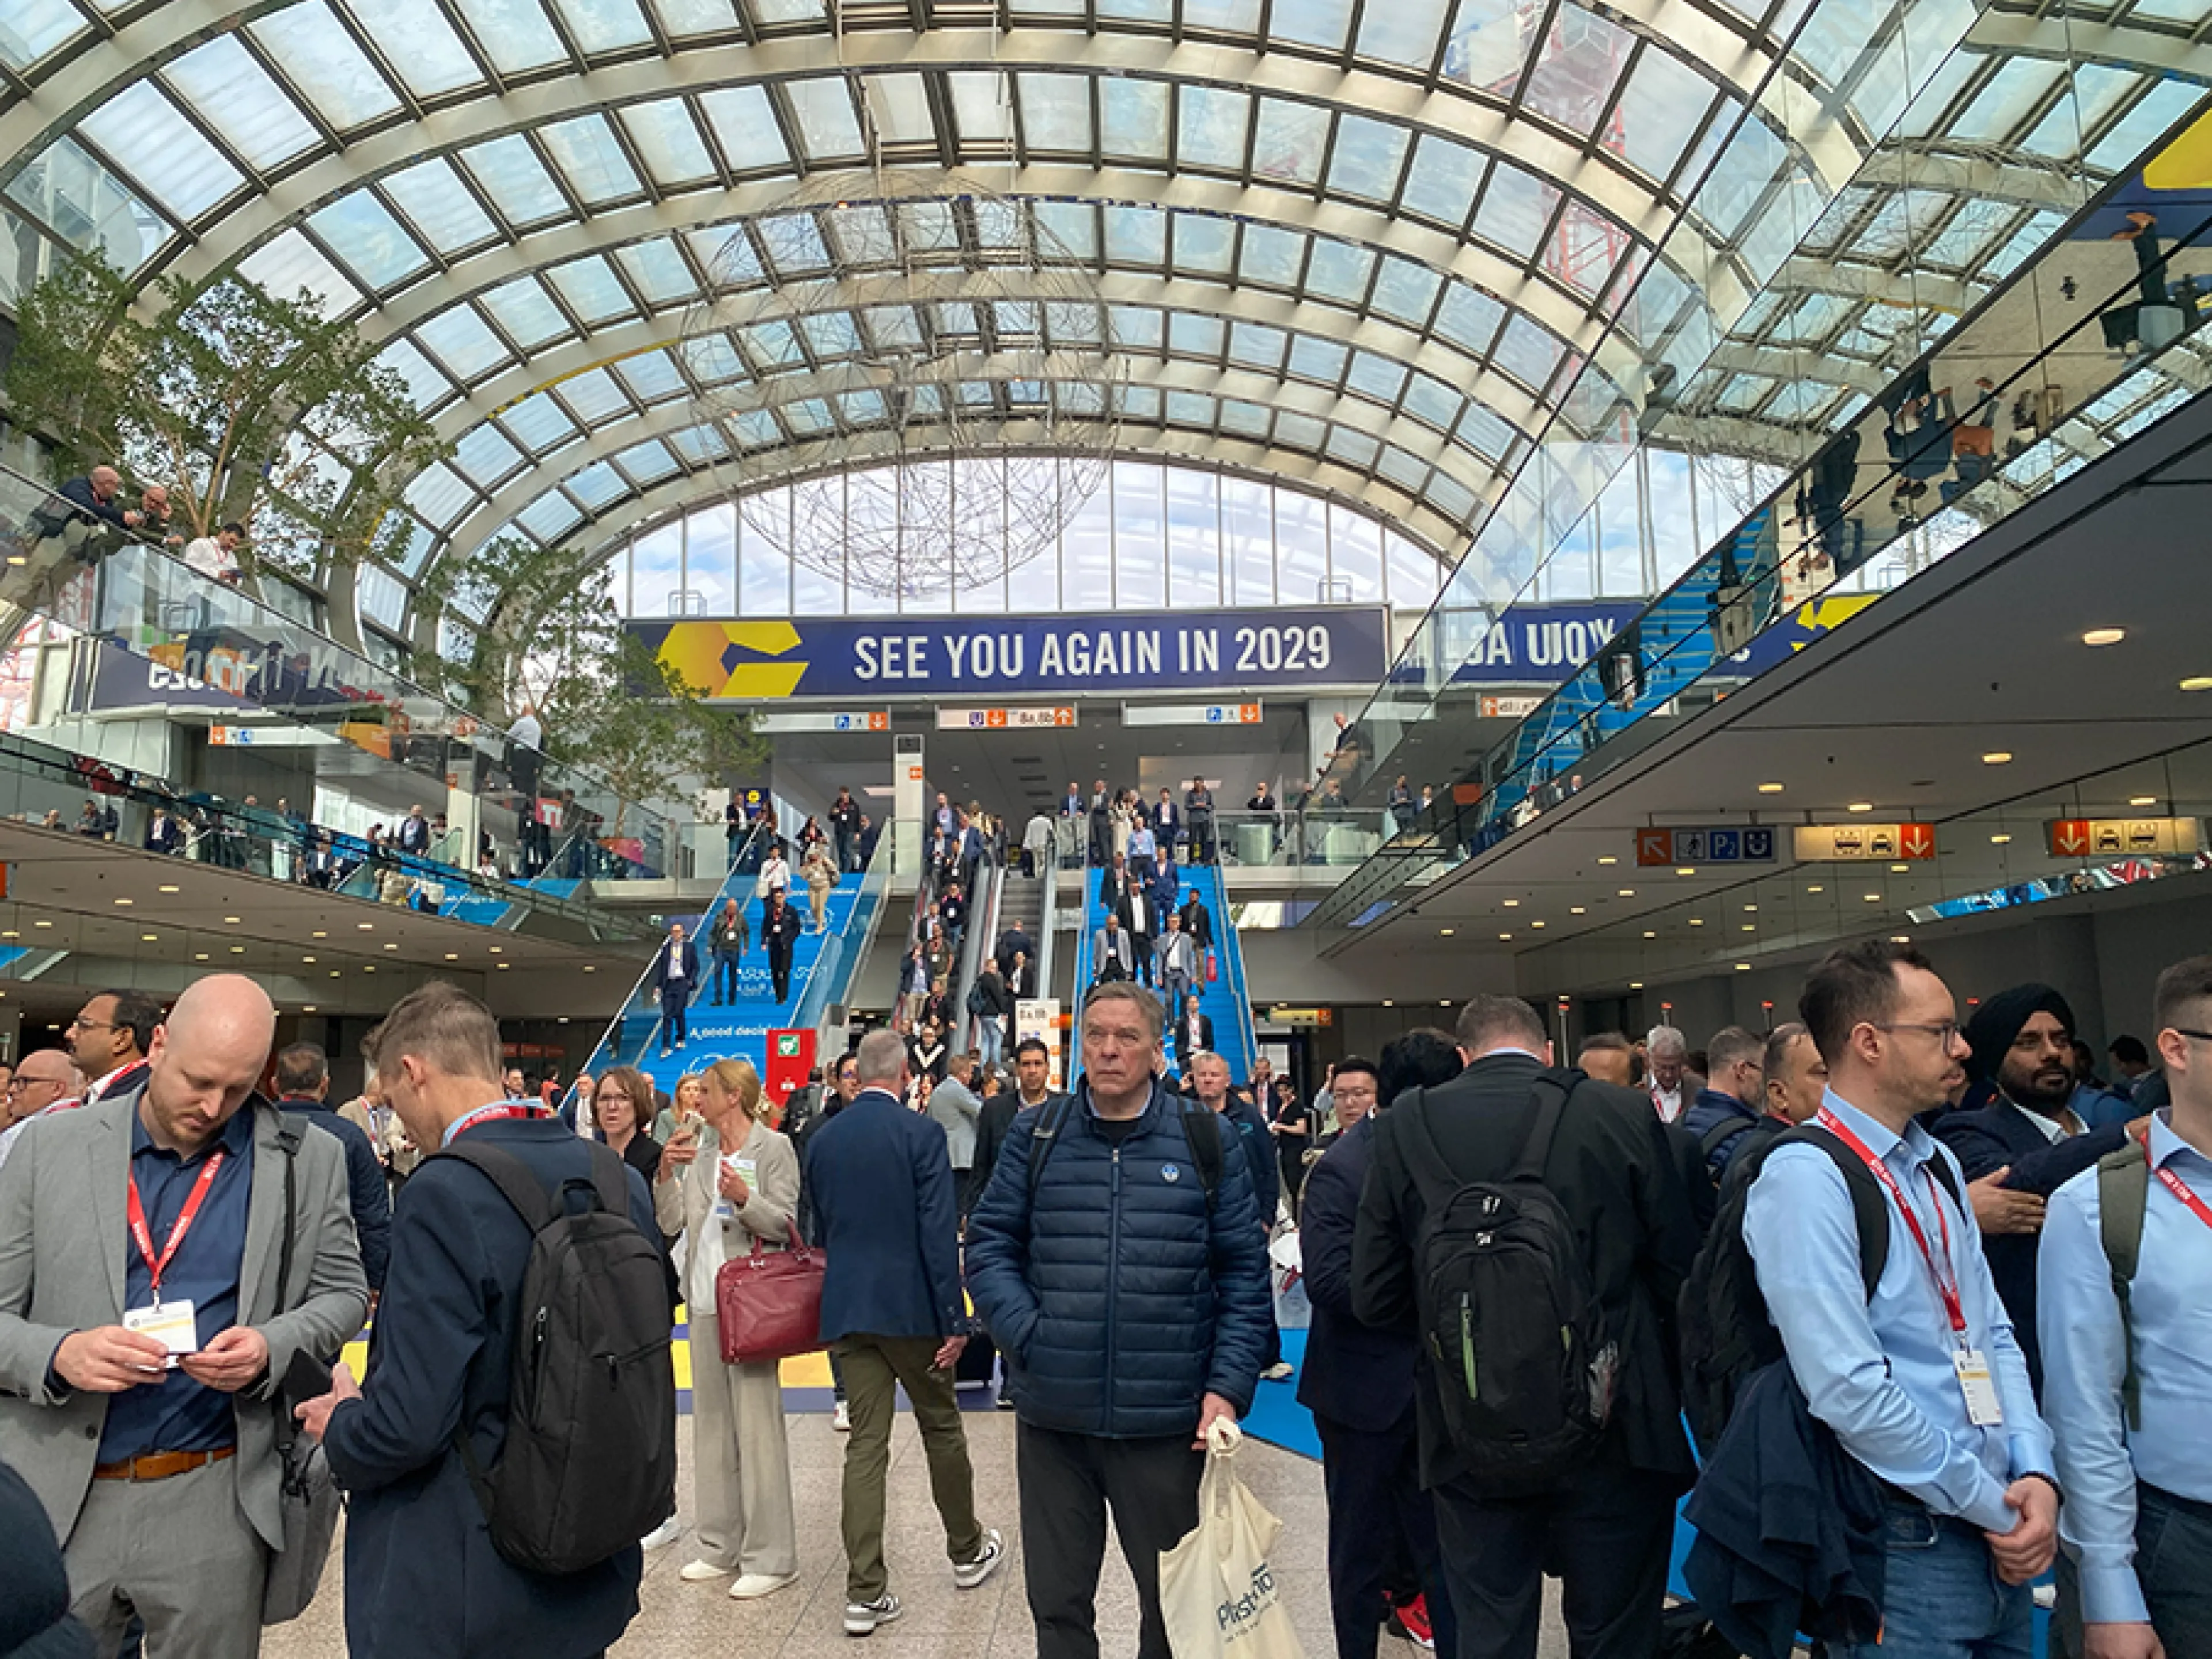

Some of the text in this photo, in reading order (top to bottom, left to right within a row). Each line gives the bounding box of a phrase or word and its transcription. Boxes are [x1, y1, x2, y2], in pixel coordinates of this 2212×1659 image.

[855, 624, 1331, 680] SEE YOU AGAIN IN 2029
